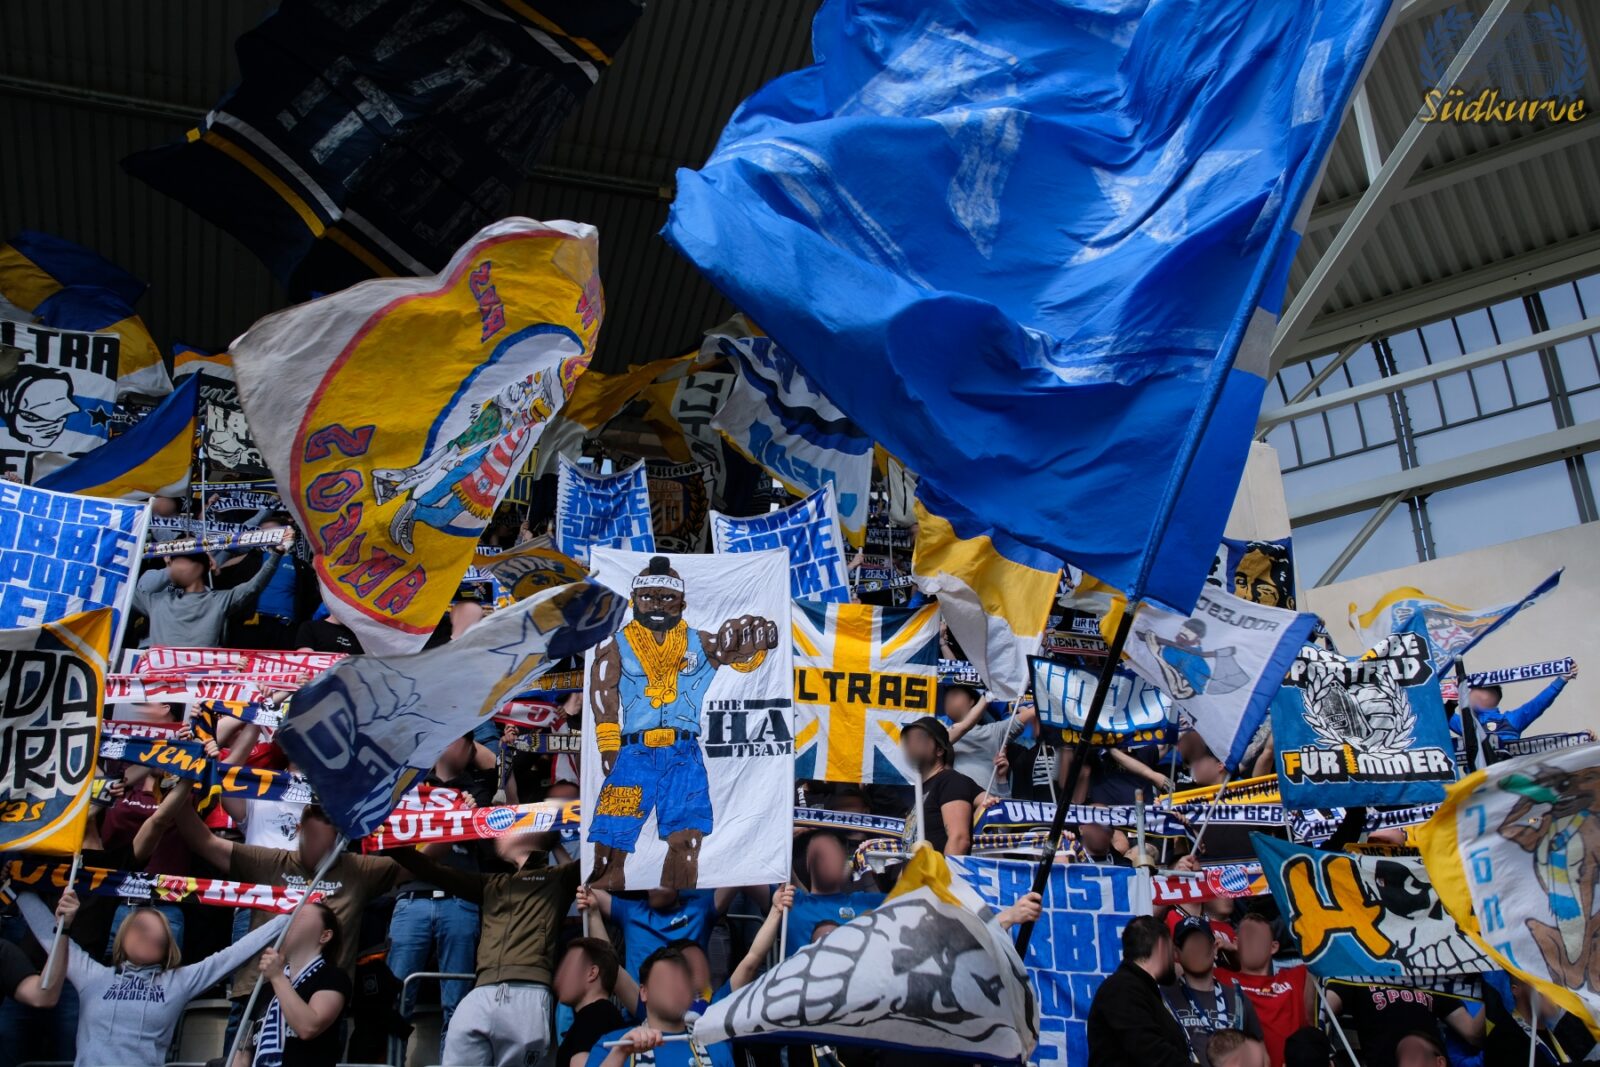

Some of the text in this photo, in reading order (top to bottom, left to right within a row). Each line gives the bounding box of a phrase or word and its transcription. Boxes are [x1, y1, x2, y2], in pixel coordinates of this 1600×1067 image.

[635, 574, 681, 588] ULTRAS
[1053, 636, 1079, 647] JENA
[1284, 656, 1421, 683] PORTFELD
[195, 682, 241, 701] SEIT
[794, 669, 928, 709] LTRAS
[707, 699, 742, 711] THE
[705, 709, 794, 745] HA
[138, 739, 207, 776] Jena
[733, 743, 793, 758] TEAM
[1283, 746, 1340, 776] FÜR
[396, 785, 461, 813] AS
[390, 808, 473, 842] ULT
[819, 809, 873, 830] ZEISS
[1004, 801, 1167, 834] UNBEUGSAM
